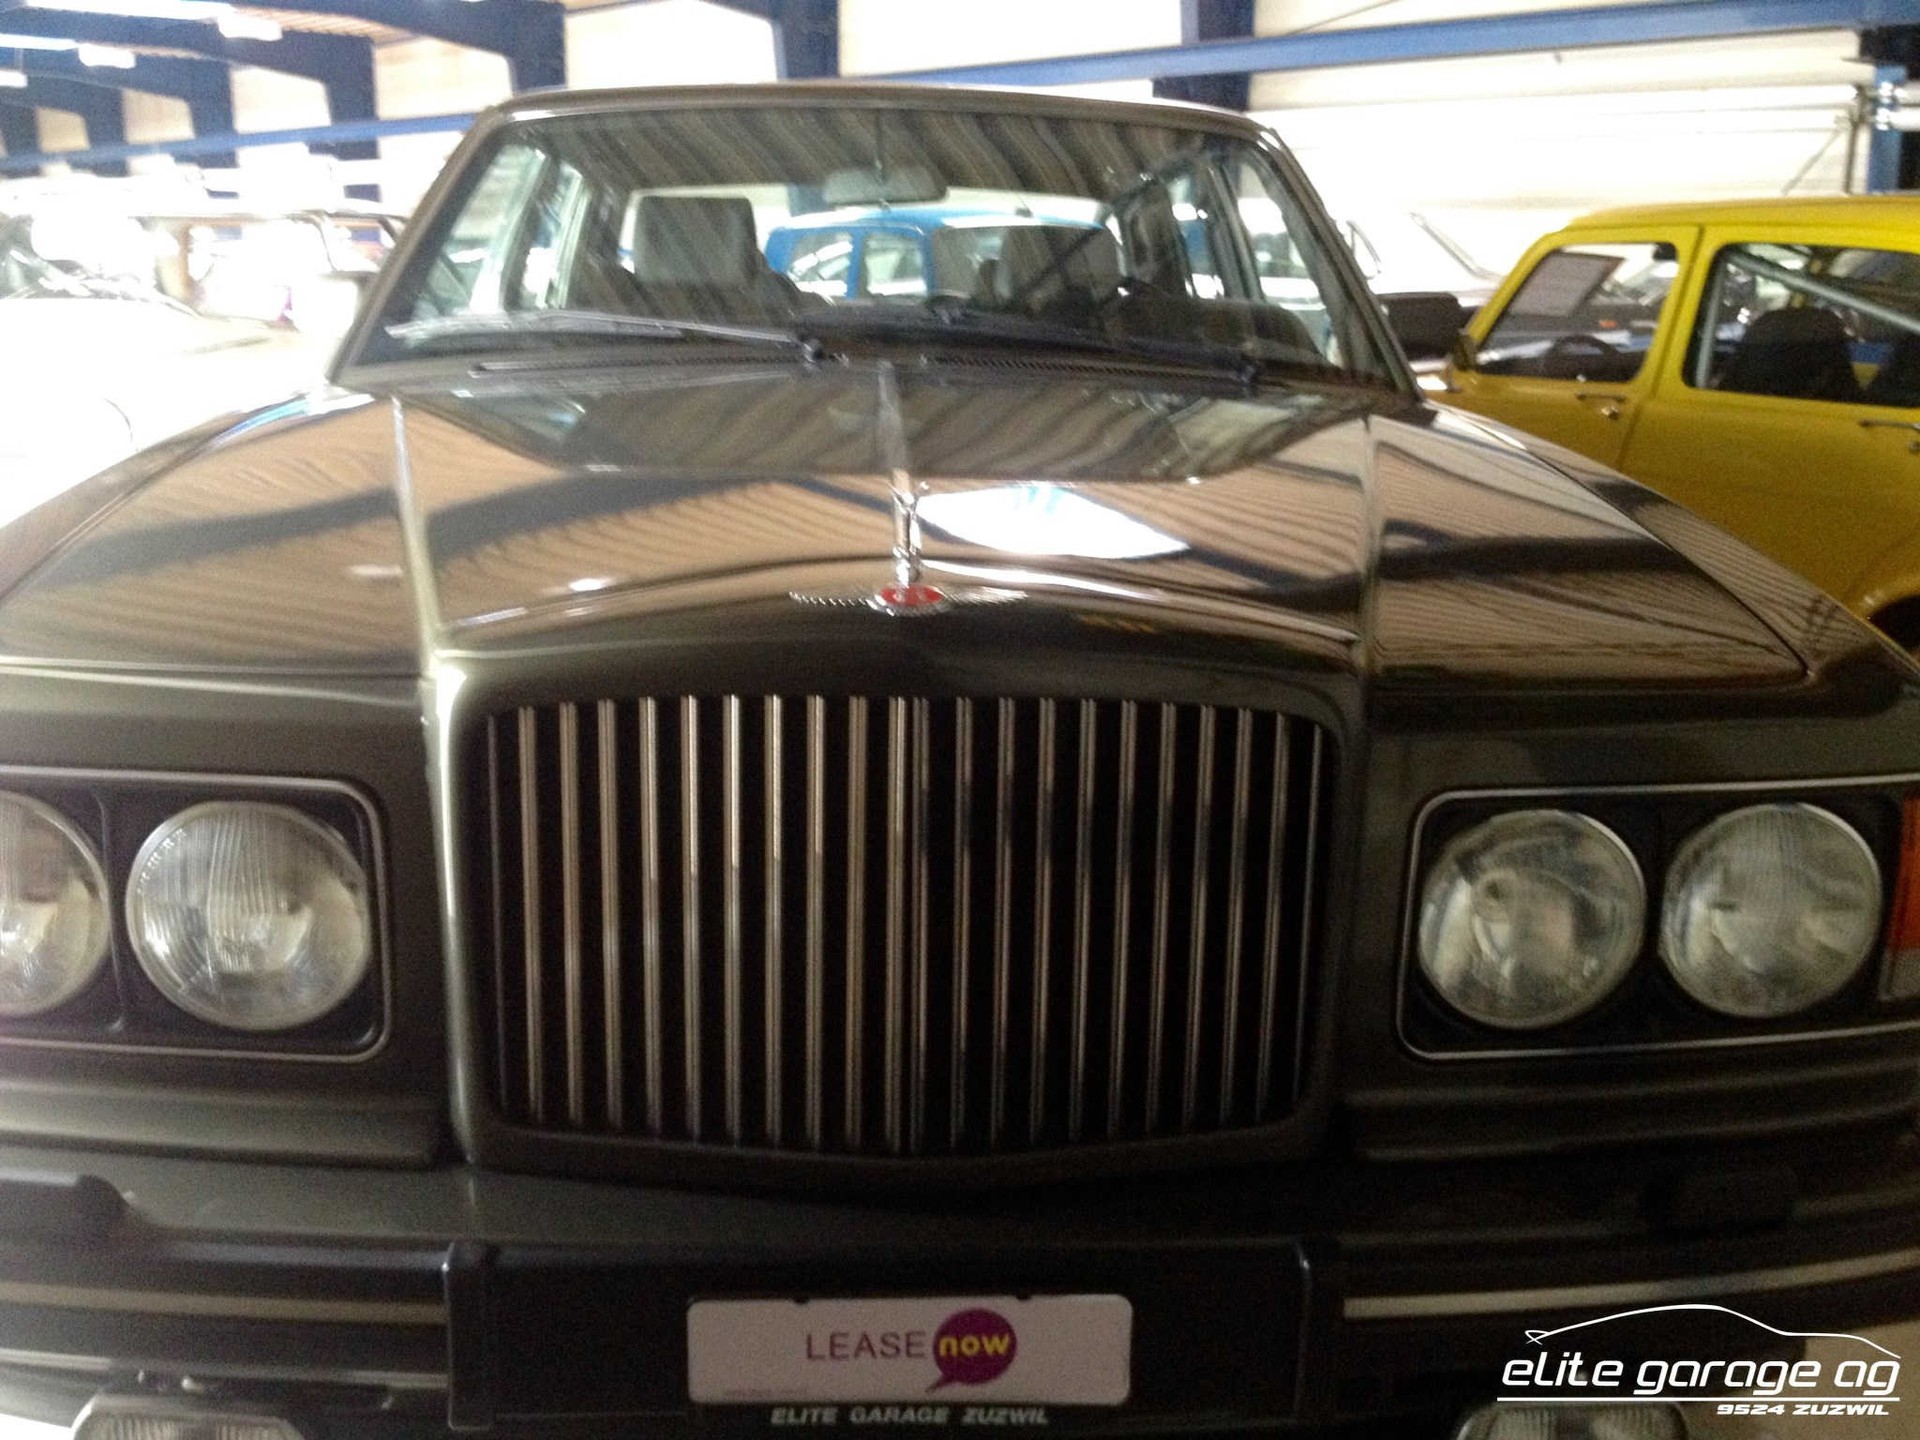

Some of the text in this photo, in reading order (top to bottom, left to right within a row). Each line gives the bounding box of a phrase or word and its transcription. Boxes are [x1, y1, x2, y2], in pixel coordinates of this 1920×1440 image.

[806, 1331, 1010, 1361] LEASE now
[770, 1406, 1049, 1425] ELITE GARAGE ZUZWIL
